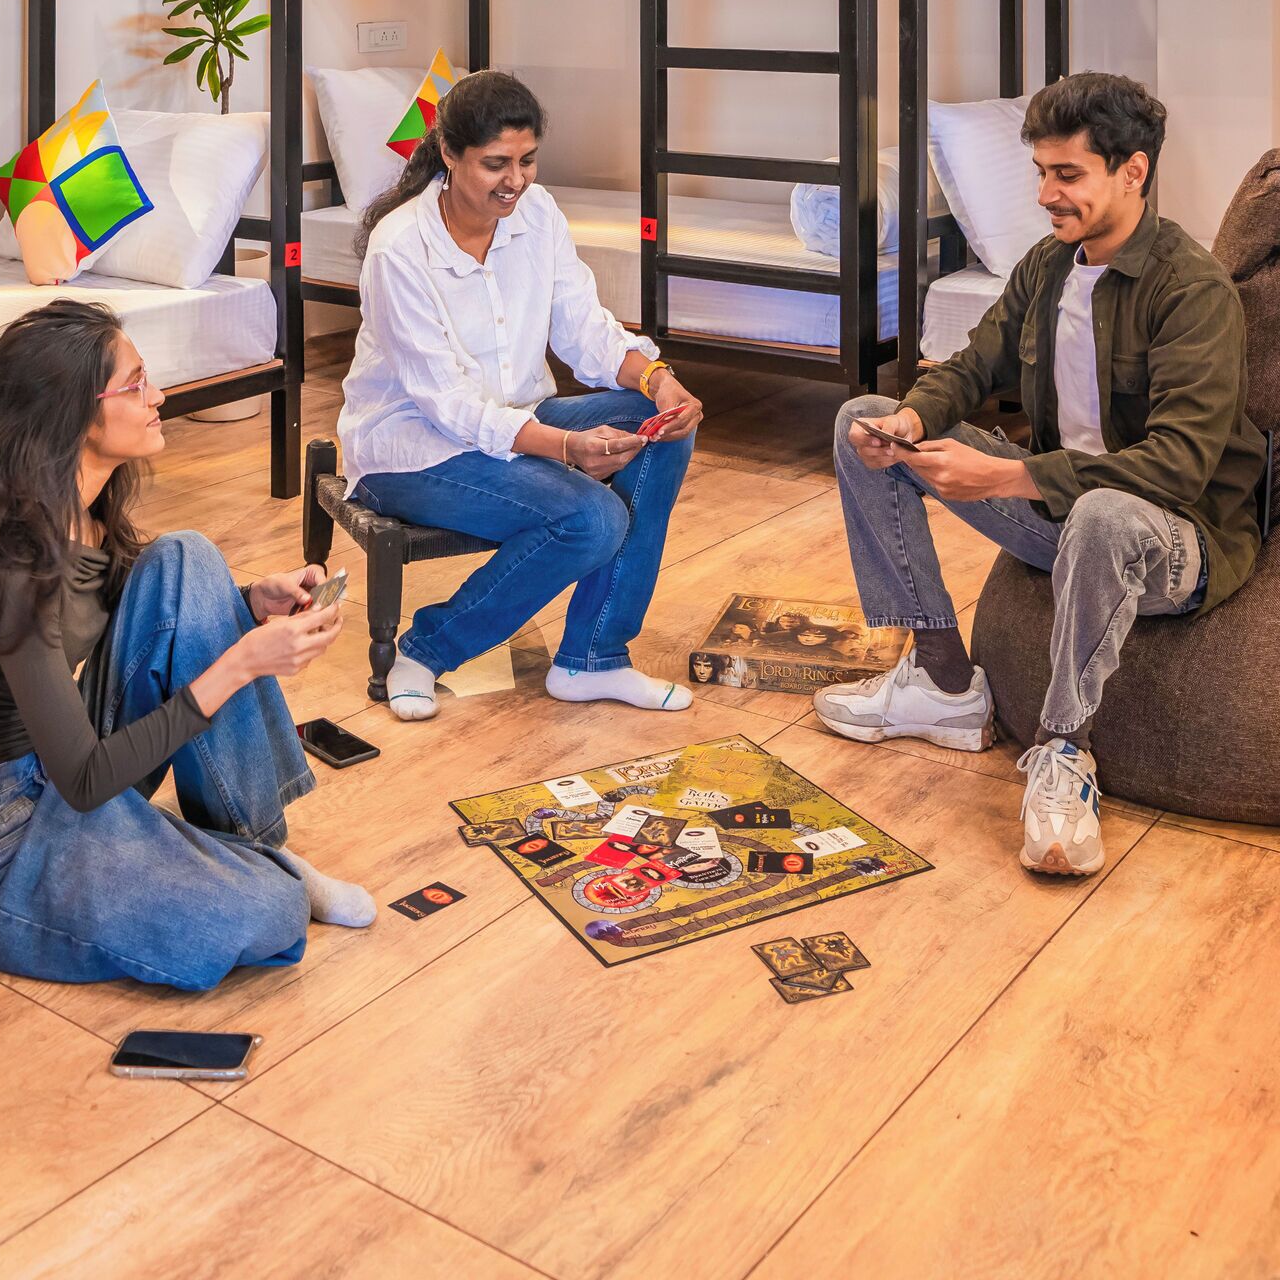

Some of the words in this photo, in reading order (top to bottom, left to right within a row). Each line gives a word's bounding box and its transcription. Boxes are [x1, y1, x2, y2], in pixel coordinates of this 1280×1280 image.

[644, 223, 652, 234] 4
[290, 248, 298, 261] 2
[760, 661, 792, 680] LORD
[802, 666, 843, 682] RINGS
[780, 682, 802, 690] BOARD
[615, 762, 670, 783] LORD
